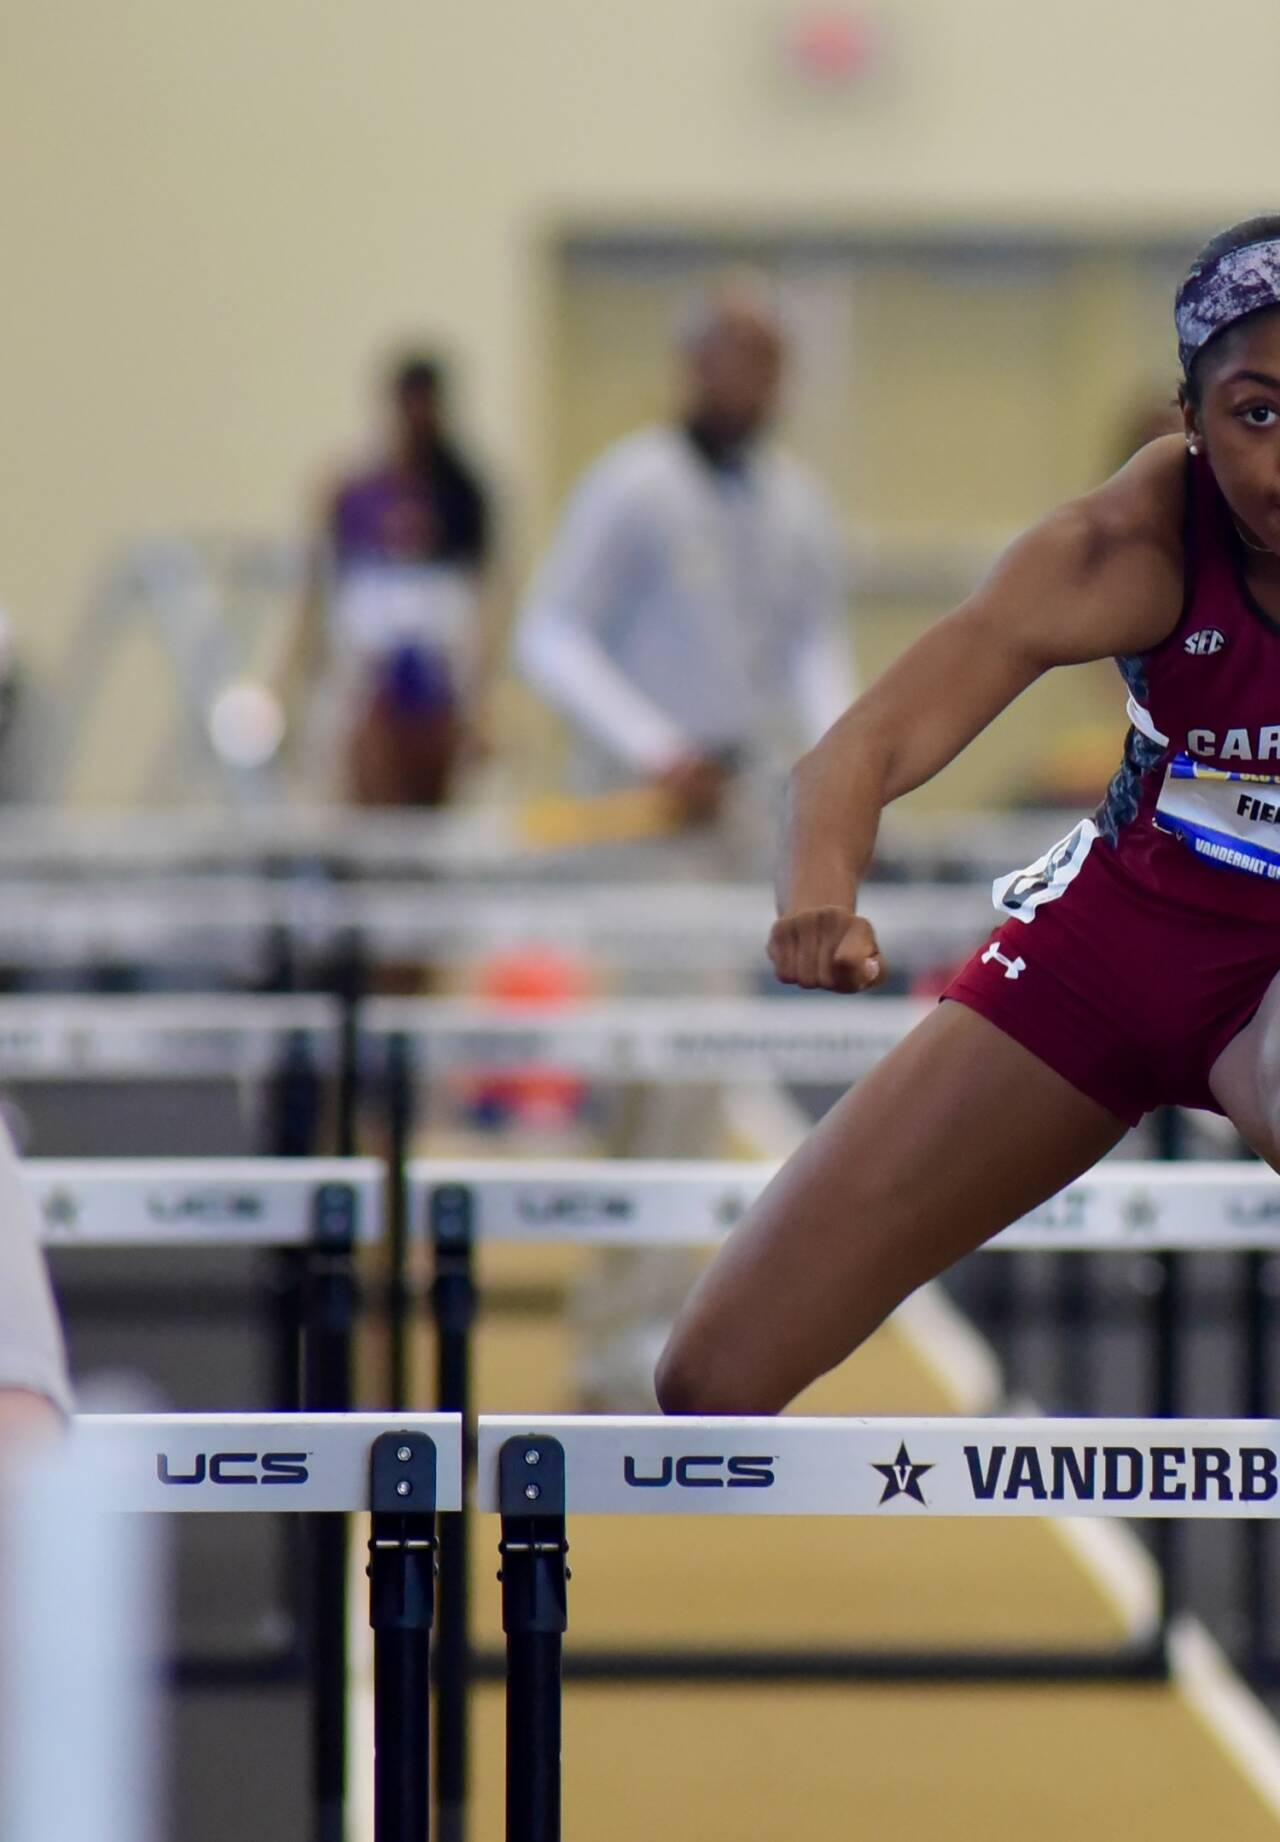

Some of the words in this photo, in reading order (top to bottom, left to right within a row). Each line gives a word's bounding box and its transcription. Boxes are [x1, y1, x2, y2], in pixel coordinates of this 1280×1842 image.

[1184, 629, 1225, 656] SEC
[1194, 837, 1265, 874] VANDERBILT
[158, 1453, 308, 1485] UCS
[624, 1456, 775, 1488] UCS
